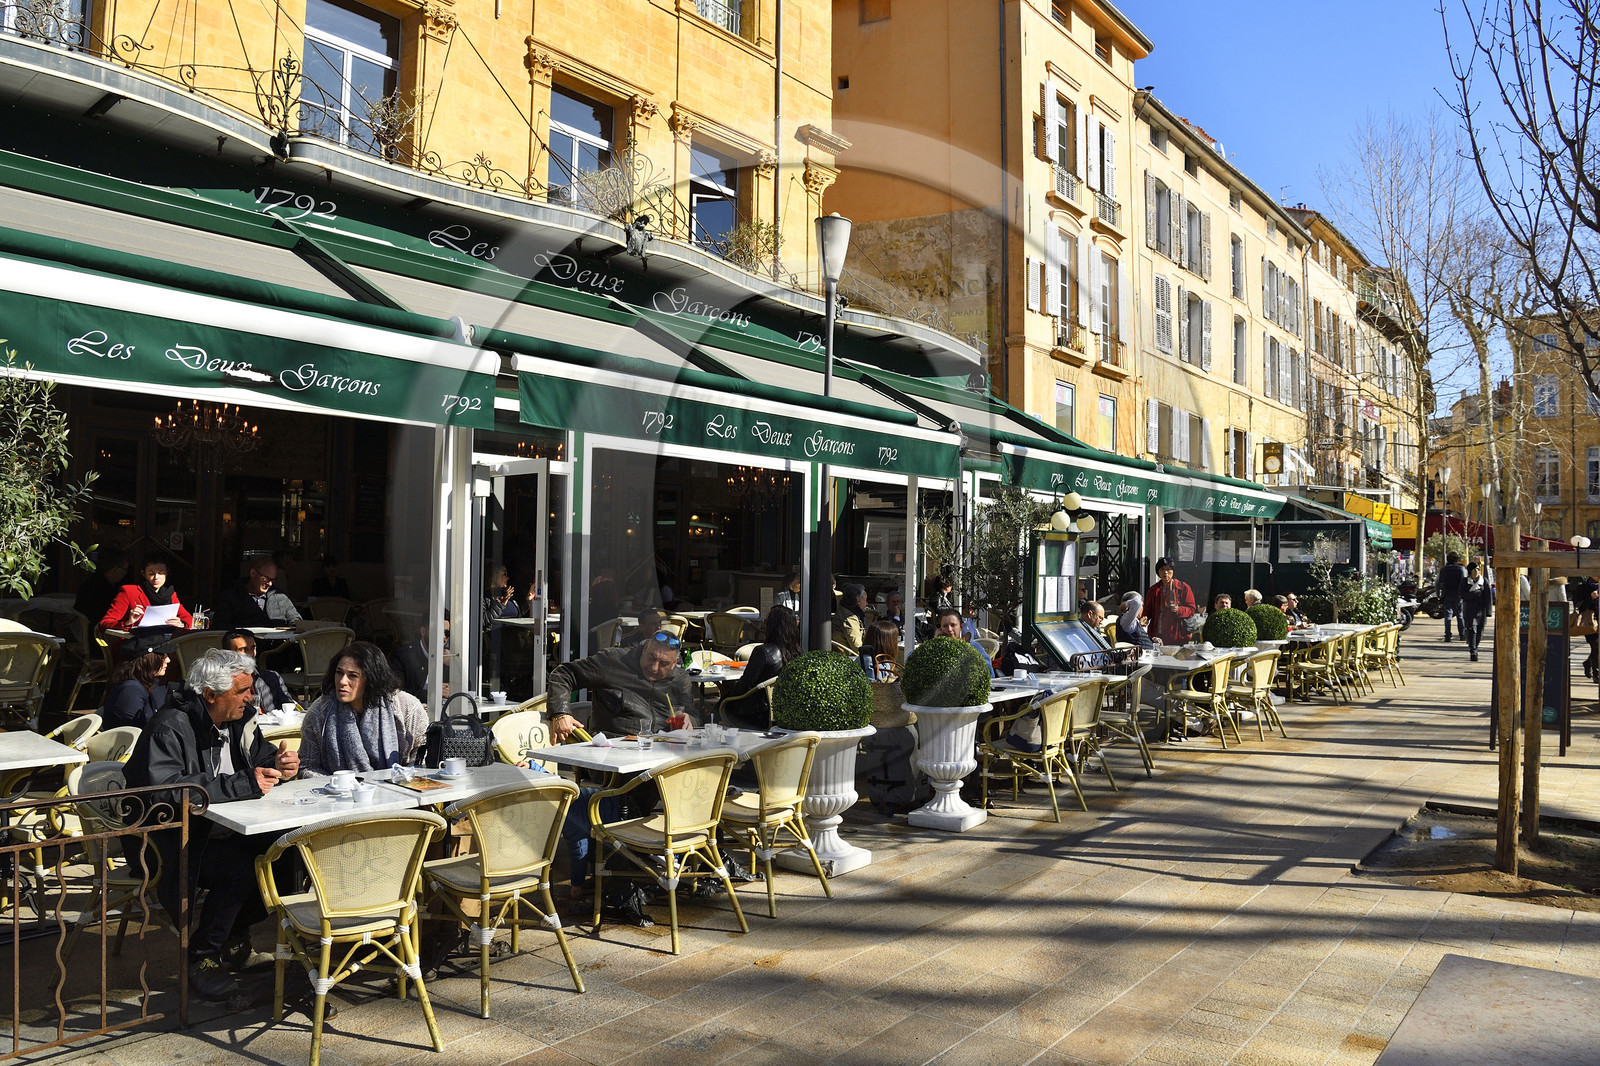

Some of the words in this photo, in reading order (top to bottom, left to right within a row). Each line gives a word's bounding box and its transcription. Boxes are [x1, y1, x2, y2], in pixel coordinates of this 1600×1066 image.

[255, 186, 338, 221] 1792
[427, 224, 500, 261] Les
[533, 250, 625, 293] Deux
[652, 287, 752, 328] Garçons
[66, 330, 135, 361] Les
[164, 342, 253, 372] Deux
[279, 363, 381, 396] Garçons
[441, 394, 481, 416] 1792
[642, 410, 674, 433] 1792
[705, 414, 738, 439] Les
[751, 420, 792, 447] Deux
[803, 430, 856, 458] Garçons
[877, 446, 898, 466] 1792
[1075, 472, 1089, 488] Les
